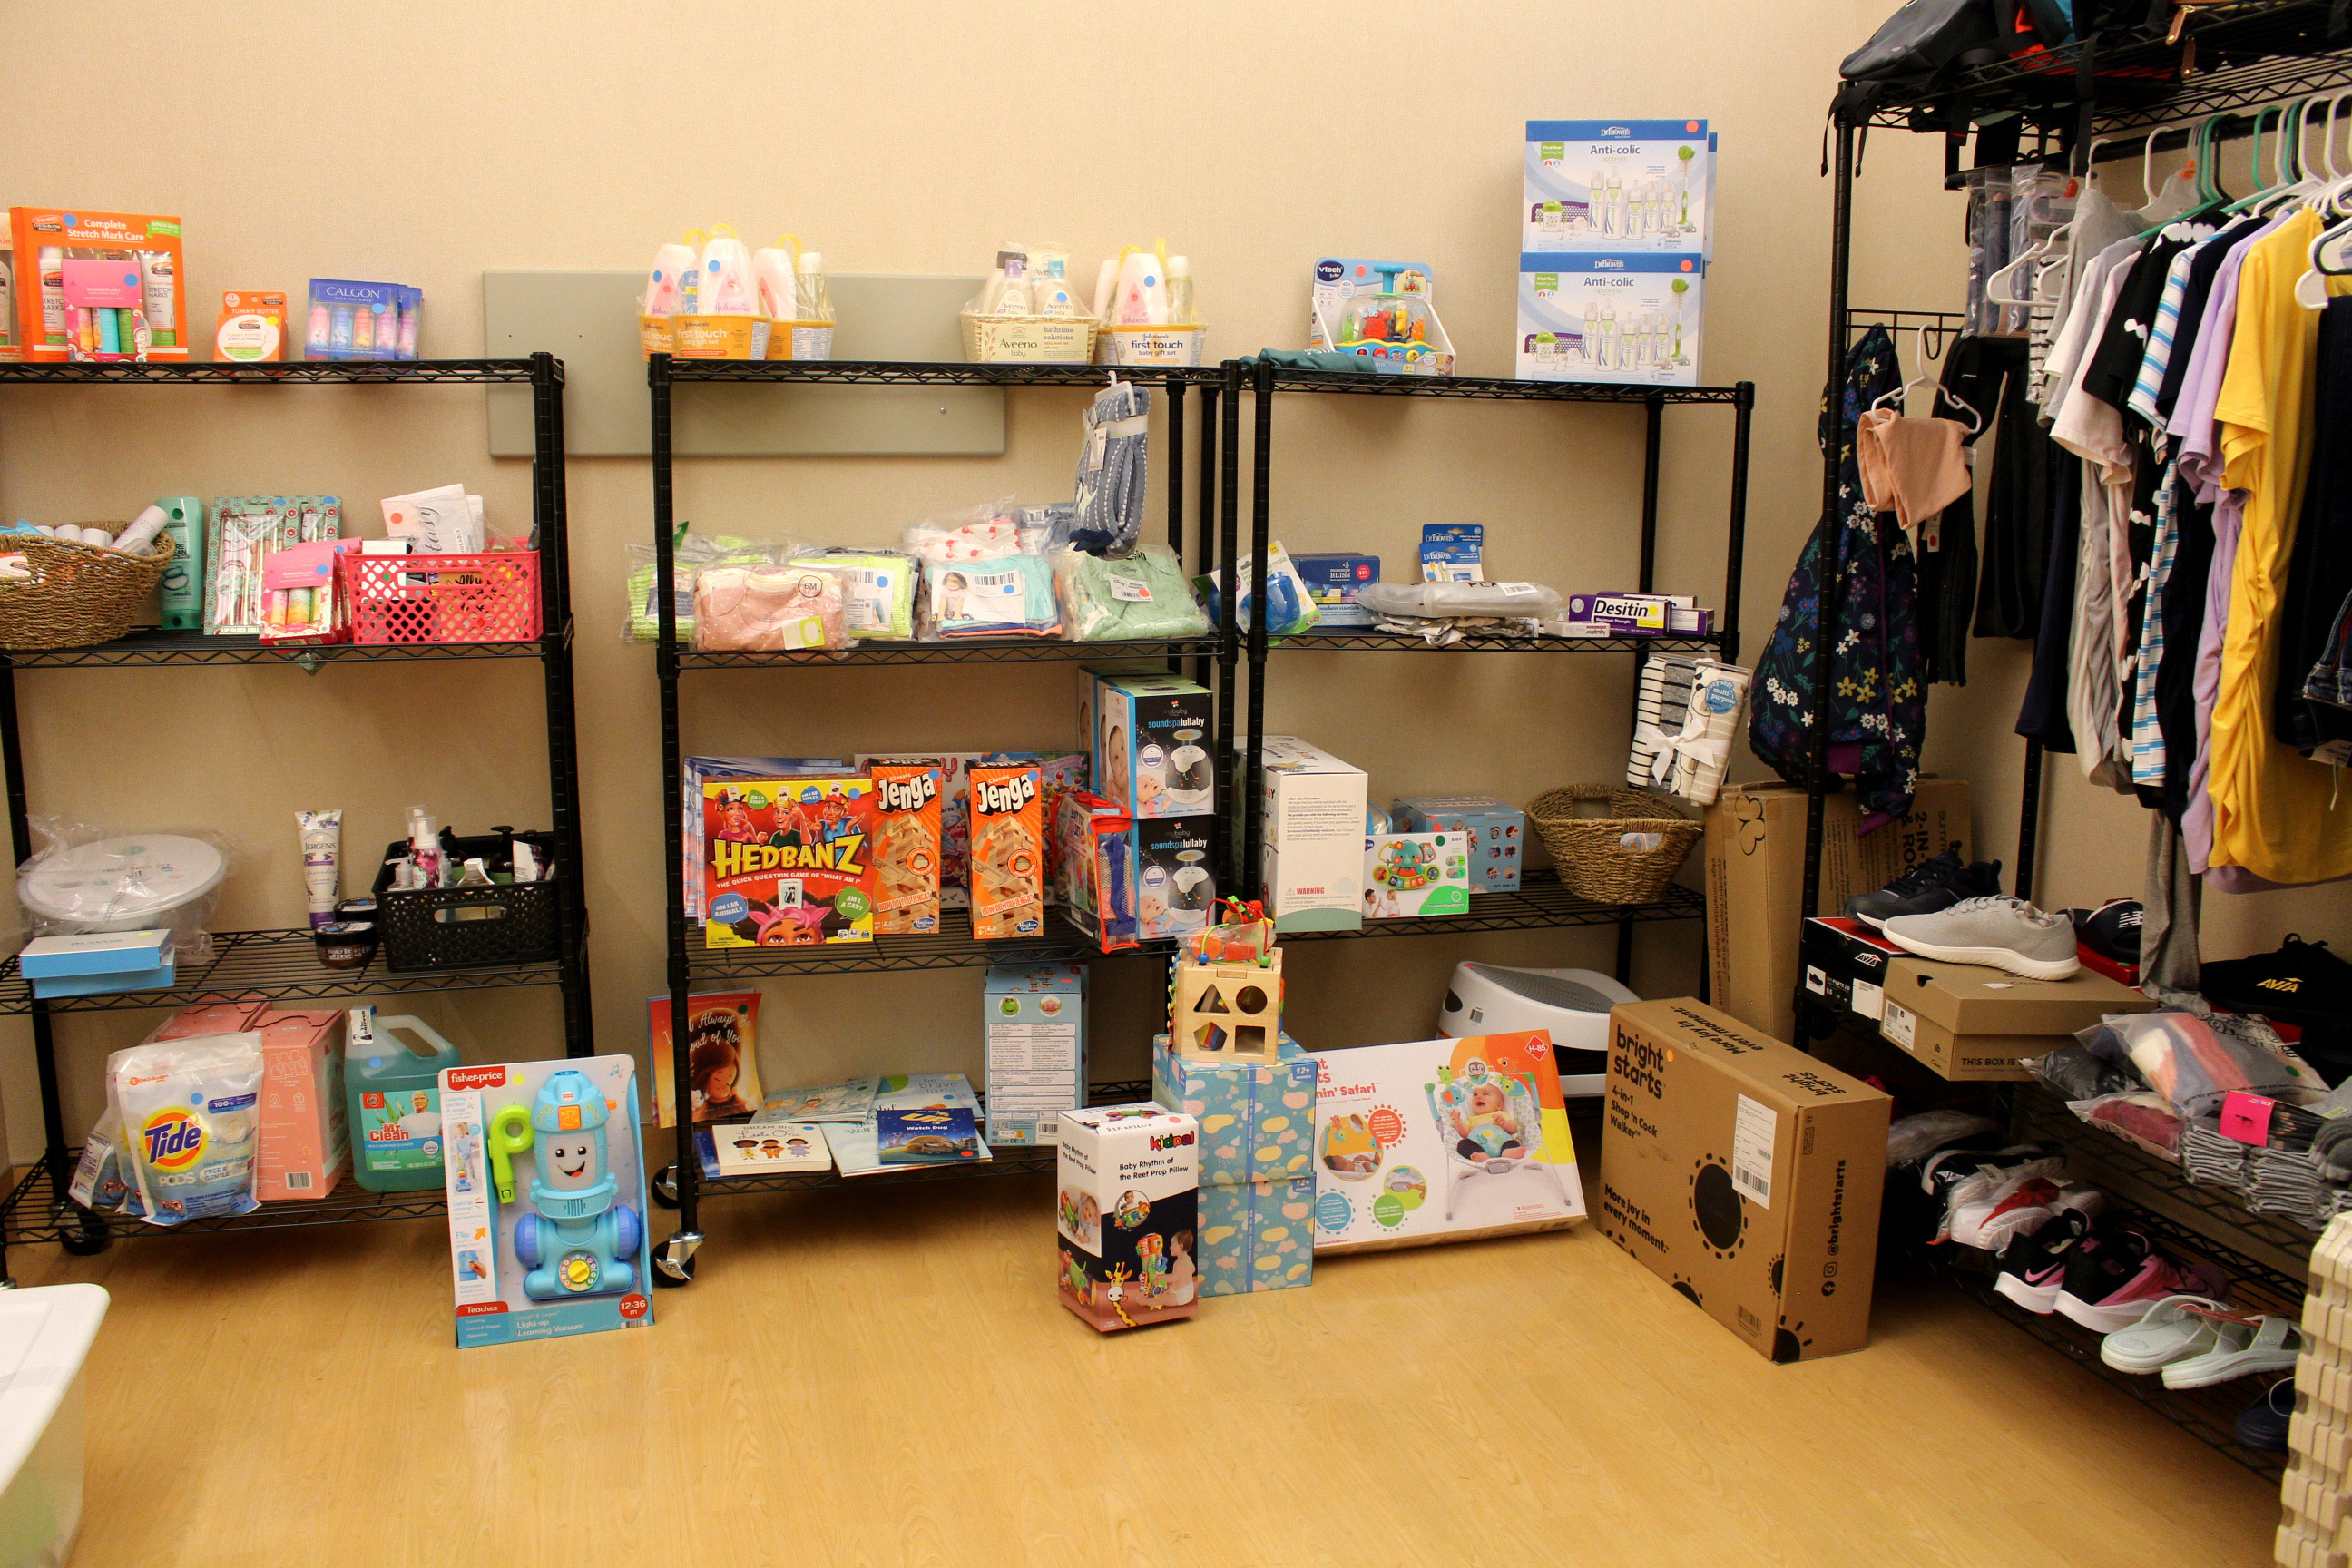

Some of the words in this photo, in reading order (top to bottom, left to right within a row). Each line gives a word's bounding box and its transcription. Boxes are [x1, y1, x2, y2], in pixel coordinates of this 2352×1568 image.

[1590, 144, 1641, 154] Anti-colic
[84, 219, 127, 230] Complete
[68, 229, 100, 239] Stretch
[102, 230, 124, 240] Mark
[125, 231, 145, 242] Care
[1318, 265, 1343, 274] vtech
[1584, 277, 1634, 288] Anti-colic
[148, 285, 172, 294] STRETCH
[149, 291, 169, 299] MARKS
[327, 287, 380, 299] CALGON
[1001, 301, 1026, 311] Aveeno
[677, 329, 693, 339] first
[695, 329, 727, 339] touch
[1044, 326, 1073, 334] bathtime
[1141, 332, 1169, 342] Johnson's
[999, 338, 1038, 349] Aveeno
[1131, 339, 1150, 349] first
[1152, 339, 1183, 349] touch
[1011, 348, 1026, 359] baby
[1138, 348, 1152, 358] baby
[1153, 348, 1165, 358] gift
[1329, 572, 1352, 583] BLISS
[804, 582, 818, 591] 6M
[1594, 599, 1648, 618] Desitin
[1586, 628, 1605, 636] Aquaphor
[1705, 680, 1720, 692] cozy
[1720, 680, 1733, 690] soft
[1712, 687, 1732, 698] multi-
[1710, 693, 1737, 705] purpose
[888, 772, 911, 781] Classic
[987, 774, 1010, 783] Classic
[877, 773, 936, 810] Jenga
[976, 774, 1035, 814] Jenga
[305, 842, 337, 852] JERGENS
[710, 832, 867, 881] HEDBANZ
[717, 882, 731, 890] THE
[732, 877, 753, 886] QUICK
[754, 873, 789, 882] QUESTION
[1296, 887, 1325, 895] WARNING
[878, 902, 891, 911] HOW
[899, 897, 911, 906] YOU
[911, 891, 932, 905] JENGA?
[981, 906, 995, 916] HOW
[1003, 900, 1015, 910] YOU
[1014, 894, 1034, 907] JENGA?
[714, 906, 743, 917] ANIMAL?
[848, 903, 864, 912] CAT?
[1857, 953, 1878, 967] AVIA
[2255, 978, 2303, 993] AVIA
[698, 1011, 736, 1030] Always
[1677, 1019, 1691, 1029] in
[710, 1029, 723, 1045] of
[725, 1028, 745, 1044] You
[1690, 1023, 1710, 1039] joy
[1710, 1036, 1747, 1054] More
[1727, 1032, 1765, 1051] every
[1528, 1044, 1547, 1054] H-85
[1616, 1024, 1664, 1073] bright
[1962, 1057, 1984, 1066] THIS
[1984, 1057, 2006, 1066] BOX
[2006, 1057, 2017, 1066] IS
[1293, 1066, 1310, 1075] 12+
[450, 1072, 504, 1083] fisher-price
[1612, 1055, 1662, 1100] starts
[1799, 1071, 1847, 1095] starts
[919, 1082, 957, 1091] brave
[1339, 1083, 1377, 1098] Safari
[1782, 1073, 1829, 1097] bright
[1612, 1084, 1634, 1107] 4-in-1
[213, 1100, 234, 1109] 100%
[1610, 1099, 1629, 1122] Shop
[1637, 1113, 1659, 1139] Cook
[383, 1123, 404, 1133] Mr.
[368, 1129, 410, 1142] Clean
[1150, 1130, 1195, 1151] kidpal
[144, 1121, 202, 1164] Tide
[1062, 1140, 1072, 1152] Baby
[1071, 1145, 1083, 1160] Rhythm
[1069, 1153, 1077, 1165] Reef
[1077, 1158, 1085, 1170] Prop
[1084, 1161, 1097, 1176] Pillow
[1120, 1162, 1138, 1172] Baby
[1139, 1159, 1165, 1170] Rhythm
[1166, 1157, 1175, 1165] of
[203, 1167, 220, 1175] FREE
[1120, 1172, 1132, 1181] the
[1132, 1171, 1150, 1180] Reef
[1150, 1169, 1168, 1179] Prop
[1168, 1165, 1189, 1176] Pillow
[158, 1171, 197, 1187] PODS
[203, 1172, 230, 1182] GENTLE
[1293, 1178, 1310, 1187] 12+
[1603, 1183, 1626, 1205] More
[1626, 1195, 1641, 1218] joy
[1640, 1210, 1651, 1225] in
[1827, 1159, 1847, 1258] @brightstarts
[1602, 1200, 1628, 1229] every
[456, 1230, 469, 1240] Flip
[466, 1305, 498, 1314] Teaches
[621, 1299, 647, 1309] 12-36
[517, 1319, 550, 1329] Light-up
[517, 1328, 553, 1338] Learning
[553, 1322, 585, 1333] Vacuum
